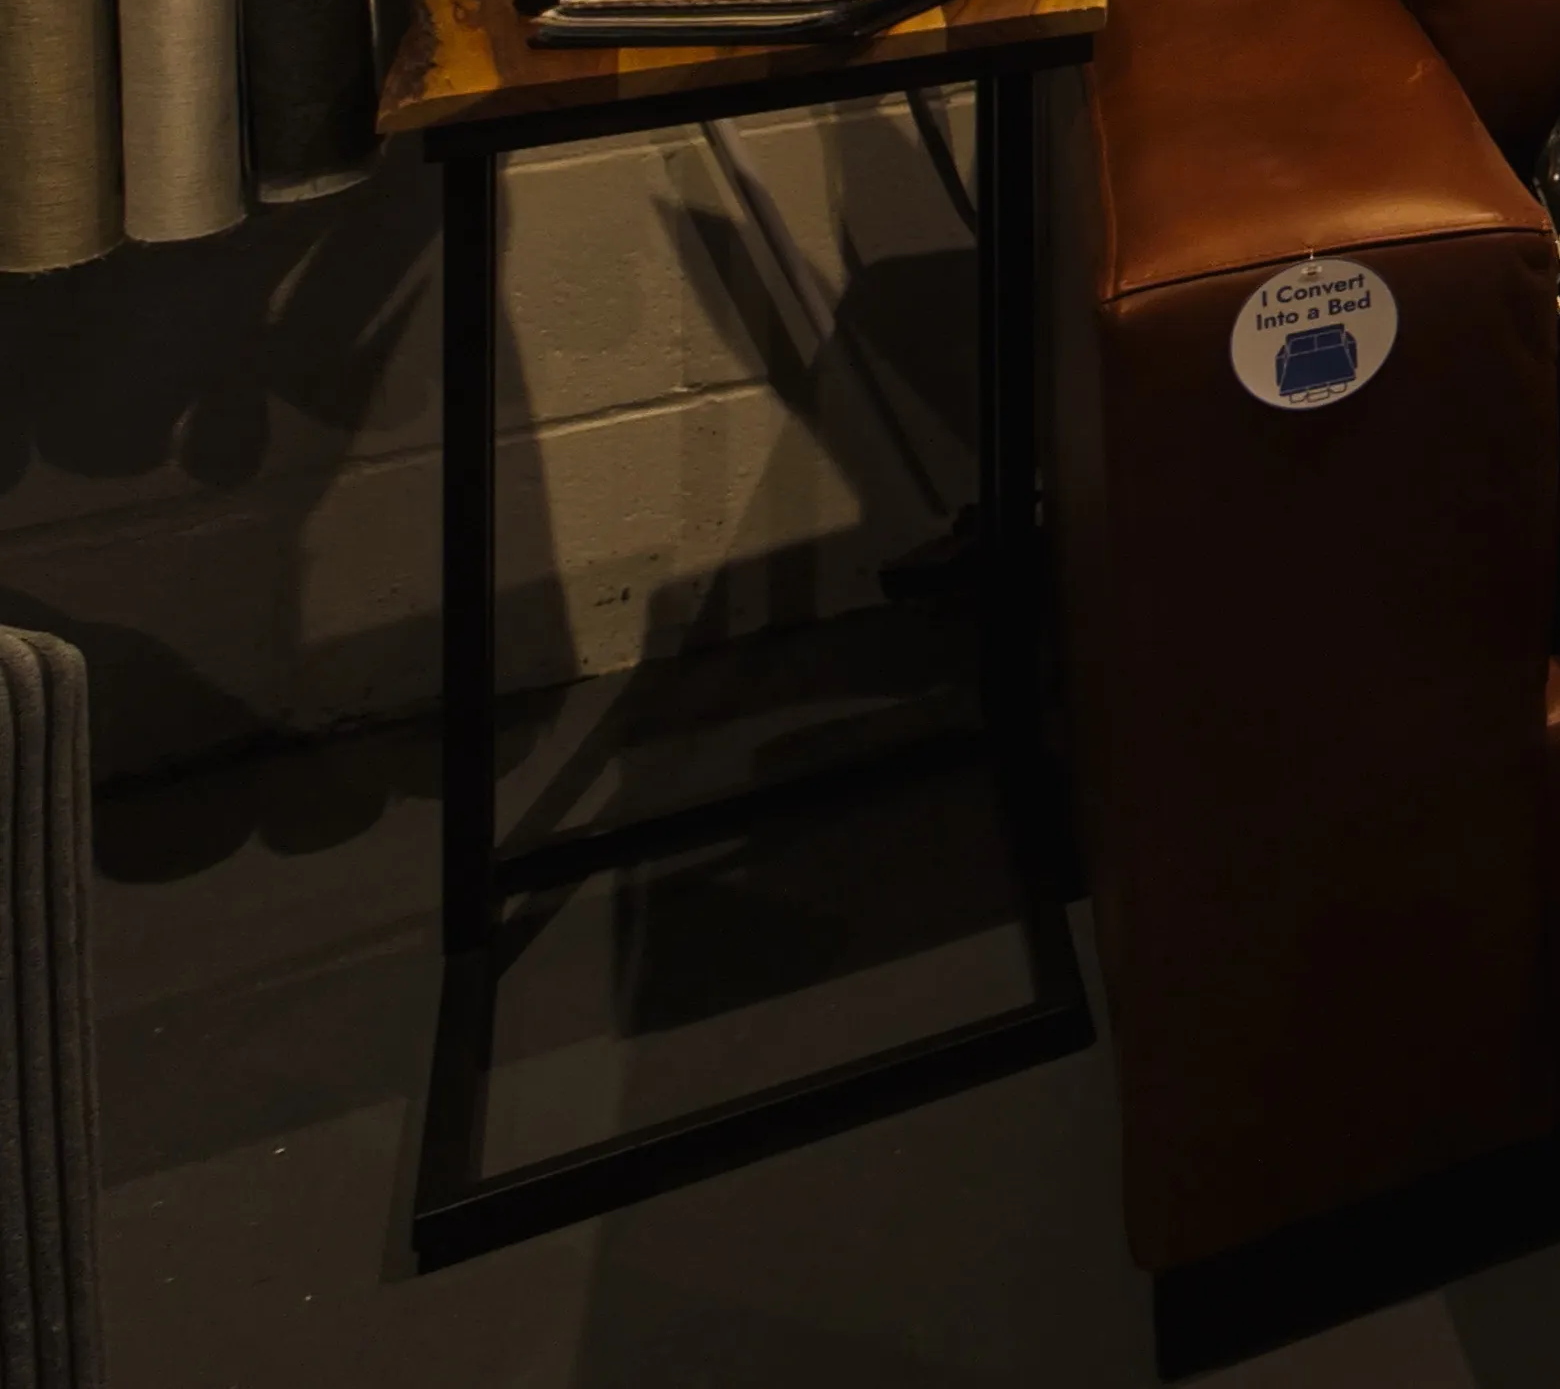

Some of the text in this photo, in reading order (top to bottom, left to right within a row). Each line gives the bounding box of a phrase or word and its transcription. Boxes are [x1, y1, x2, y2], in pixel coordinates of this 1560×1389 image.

[1262, 273, 1365, 307] I Convert
[1257, 290, 1371, 331] Into a Bed
